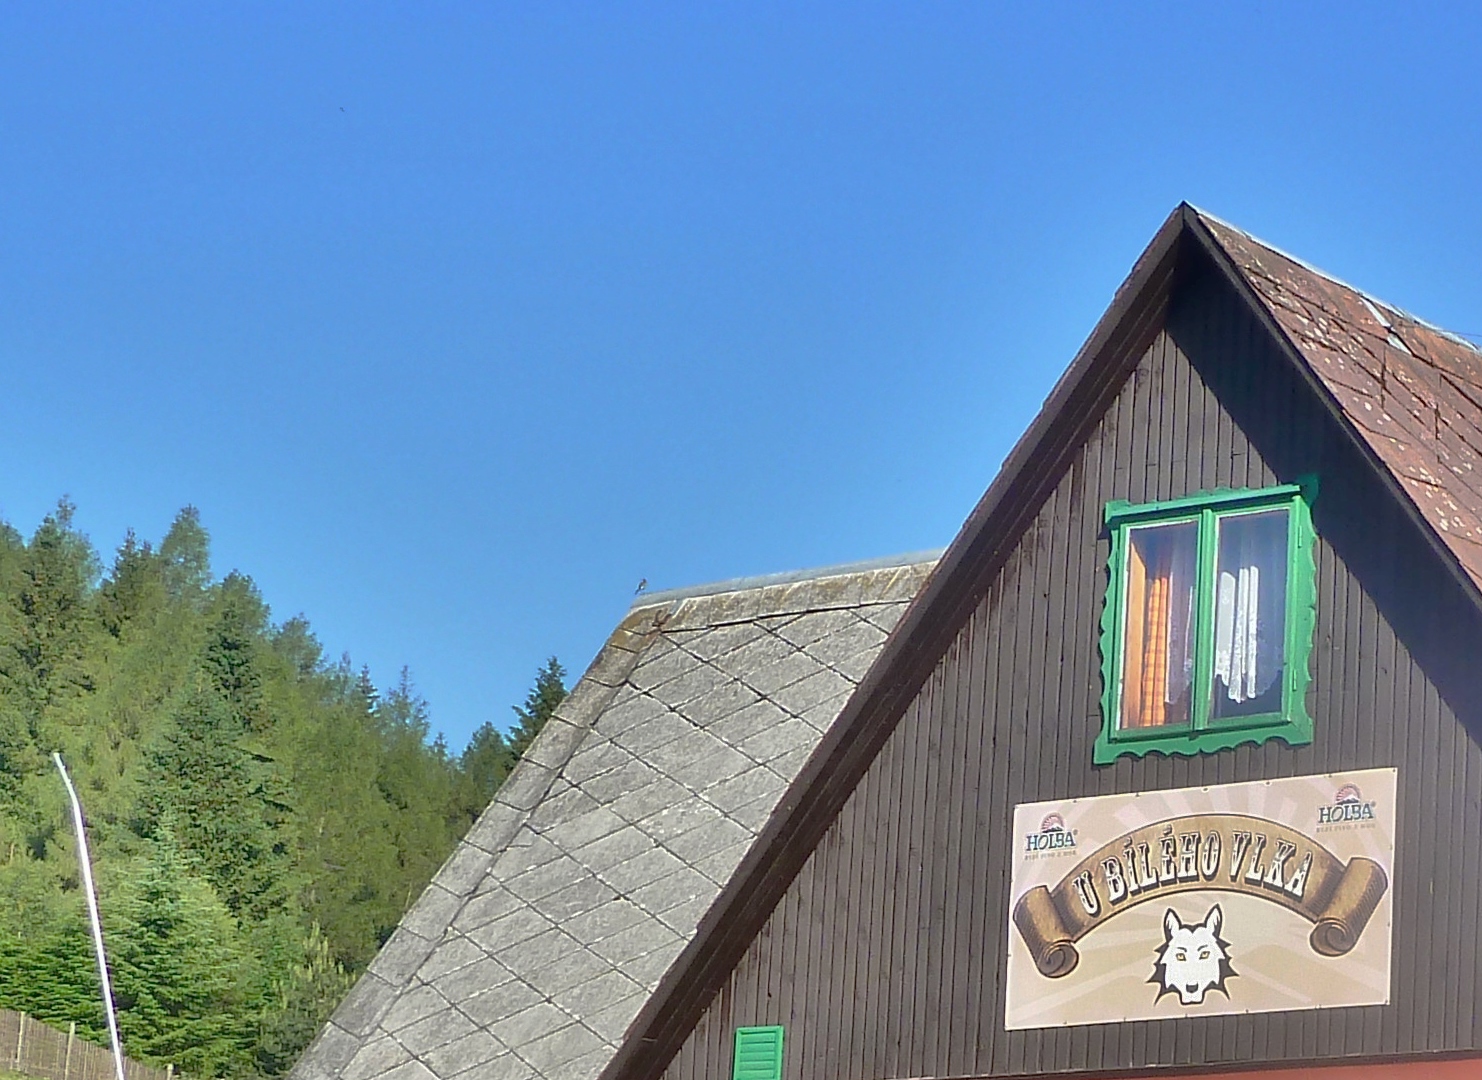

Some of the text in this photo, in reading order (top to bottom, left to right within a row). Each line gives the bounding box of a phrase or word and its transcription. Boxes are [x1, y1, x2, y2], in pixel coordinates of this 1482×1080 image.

[1317, 803, 1375, 824] HOLBA
[1025, 831, 1077, 852] HOLBA
[1073, 824, 1313, 917] U BÍLÉHO VLKA
